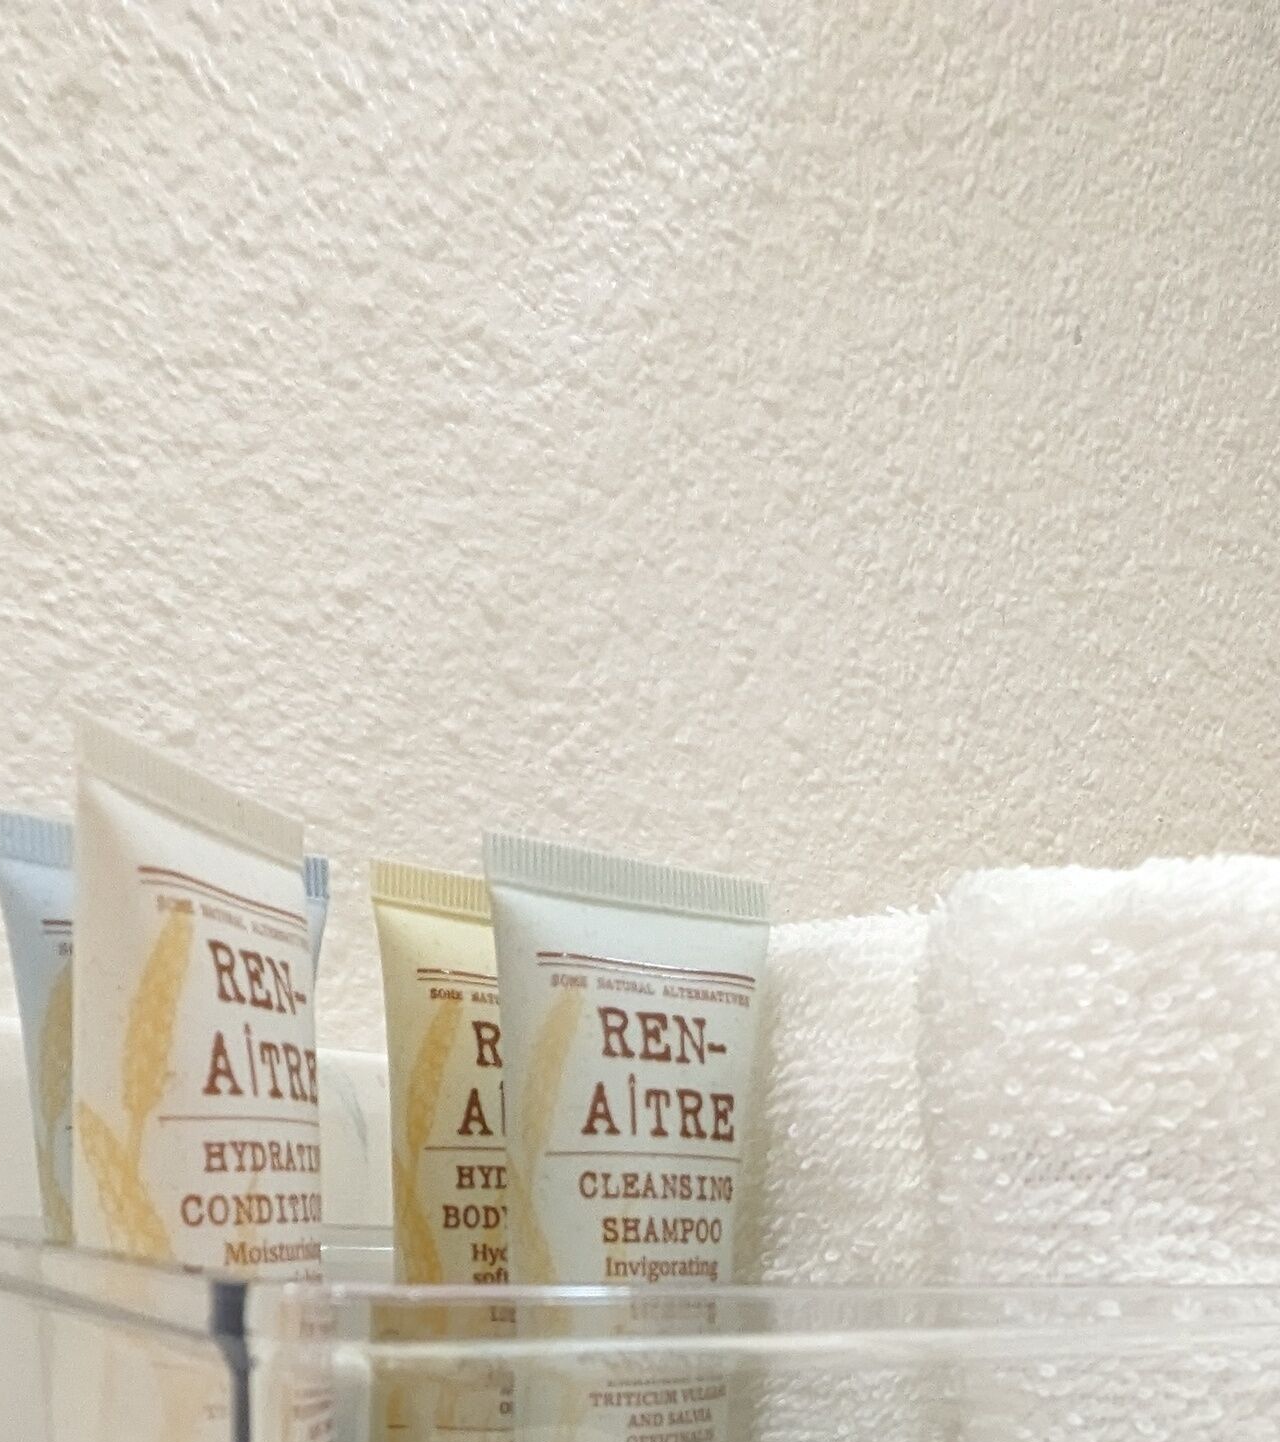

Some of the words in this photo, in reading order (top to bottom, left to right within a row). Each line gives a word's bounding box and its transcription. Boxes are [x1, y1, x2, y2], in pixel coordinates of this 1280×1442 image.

[206, 938, 307, 1015] REN-
[596, 976, 655, 996] NATURAL
[663, 985, 751, 1009] ALTERNATIVES
[597, 1006, 727, 1065] REN-
[579, 1170, 735, 1204] CLEANSING
[602, 1217, 722, 1246] SHAMPOO
[605, 1256, 718, 1283] Invigorating
[589, 1389, 677, 1407] TRITICUM
[628, 1412, 664, 1428] AND
